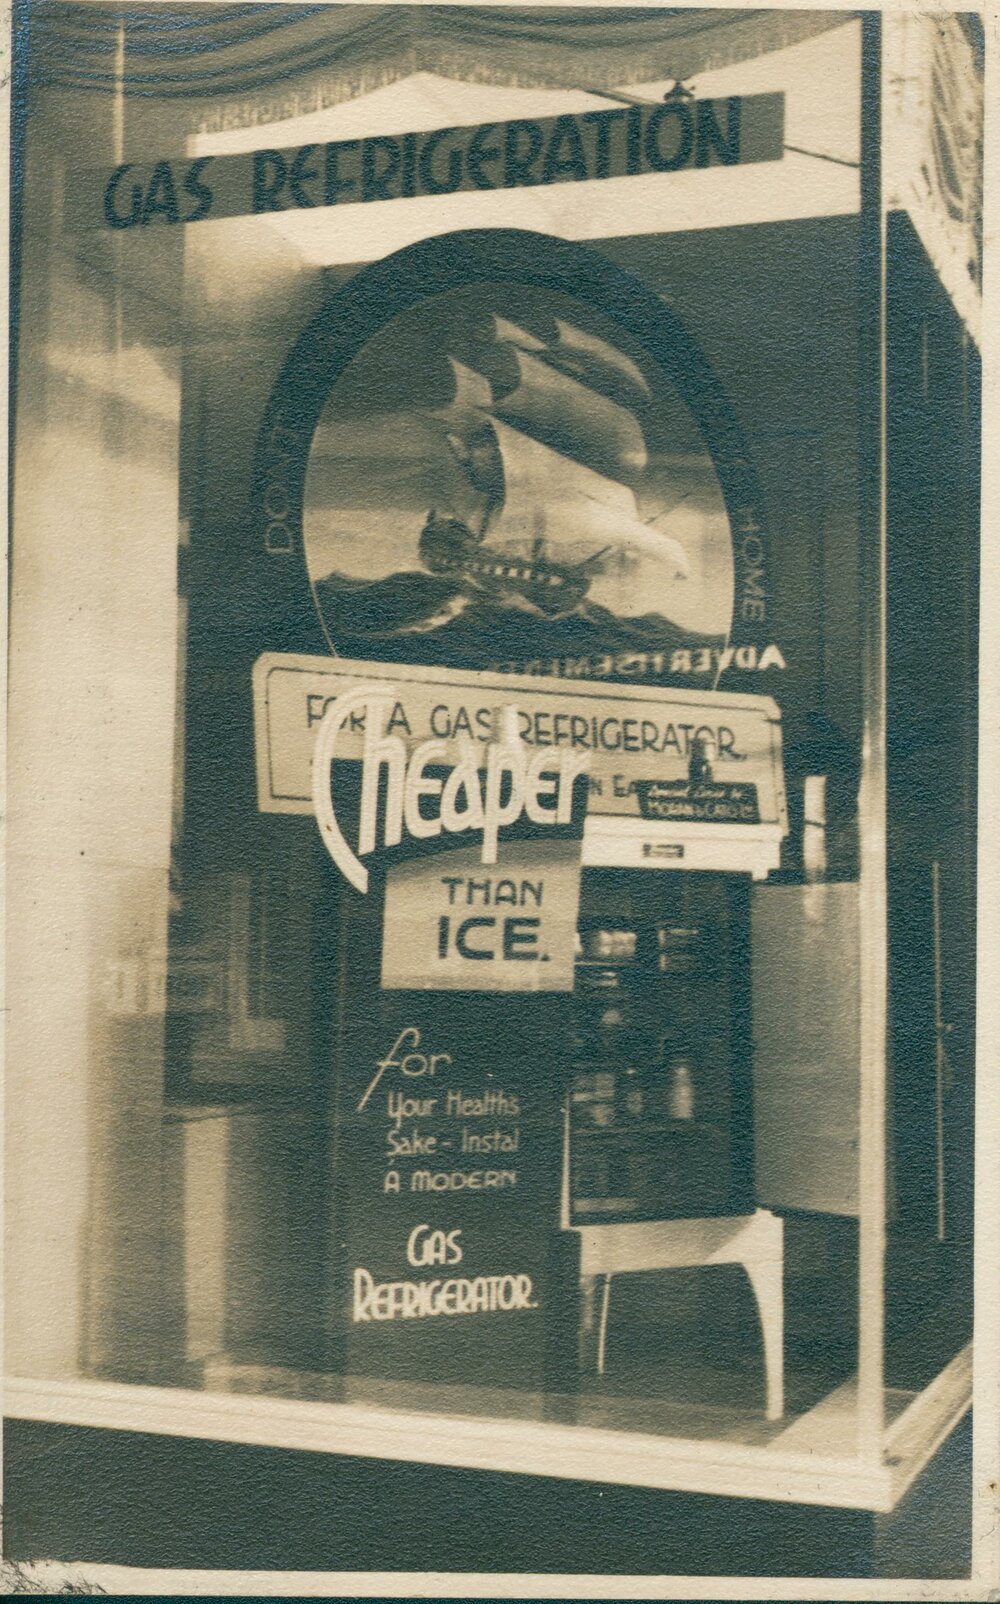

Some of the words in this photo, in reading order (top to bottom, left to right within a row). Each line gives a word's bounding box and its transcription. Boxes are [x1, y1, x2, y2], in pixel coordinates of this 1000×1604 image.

[102, 156, 215, 231] GAS
[252, 94, 743, 213] REFRIGERATION
[736, 508, 767, 622] HOME
[386, 701, 412, 737] A
[429, 704, 492, 742] GAS
[441, 877, 544, 906] THAN
[438, 915, 550, 961] ICE.
[387, 1090, 438, 1129] Your
[462, 1126, 520, 1152] Instal
[383, 1170, 401, 1193] A
[411, 1168, 517, 1192] MODERN
[406, 1223, 463, 1267] GAS
